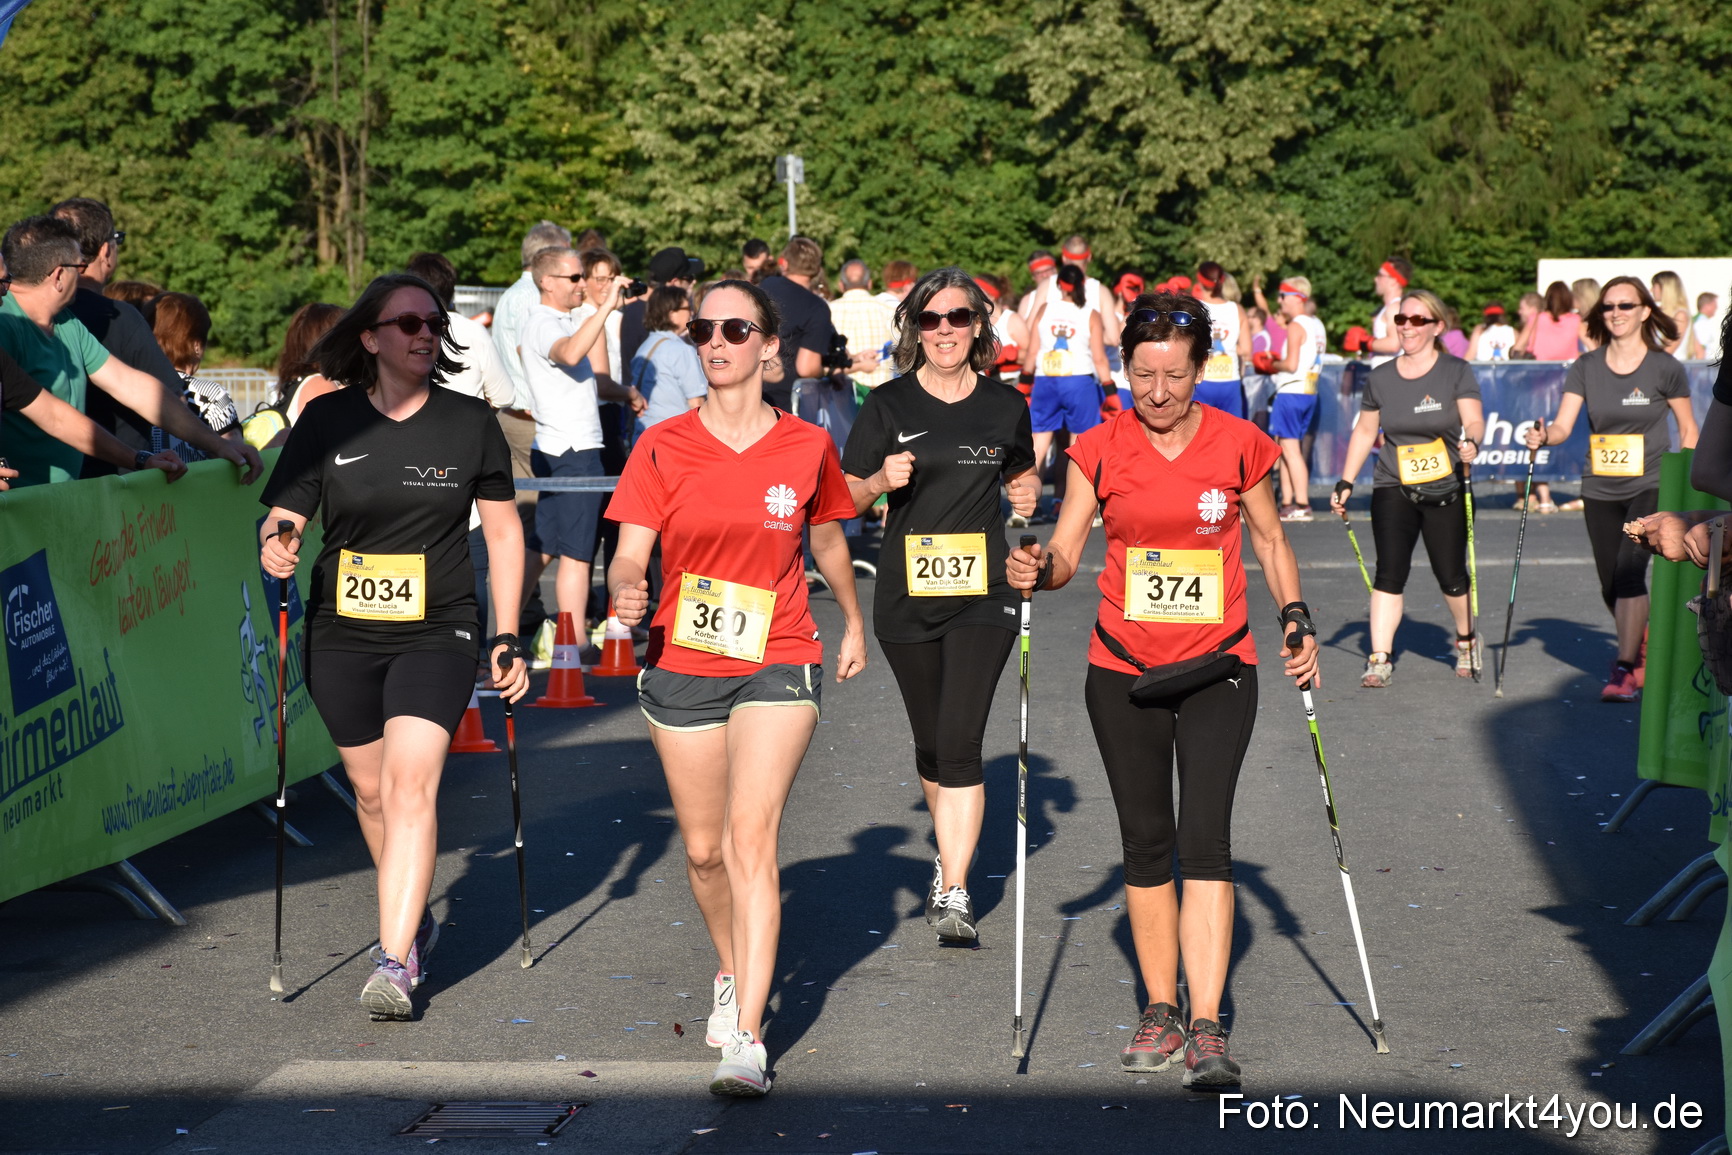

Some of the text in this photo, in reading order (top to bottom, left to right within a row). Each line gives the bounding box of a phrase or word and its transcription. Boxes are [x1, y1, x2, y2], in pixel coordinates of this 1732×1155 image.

[1410, 456, 1440, 473] 323
[1472, 450, 1550, 465] MOBILE
[1601, 449, 1629, 464] 322
[764, 520, 793, 532] caritas
[90, 510, 137, 587] Gerade
[916, 556, 976, 579] 2037
[345, 576, 413, 602] 2034
[1147, 575, 1203, 602] 374
[1143, 609, 1195, 617] Caritas-Sozialstation
[1150, 602, 1200, 611] Helgert Petra
[13, 601, 53, 637] Fischer
[693, 603, 747, 637] 360
[21, 624, 55, 650] AUTOMOBILE
[694, 629, 718, 641] Körber
[3, 772, 64, 834] neumarkt
[102, 746, 235, 836] www.firmenlauf-oberpfalz.de
